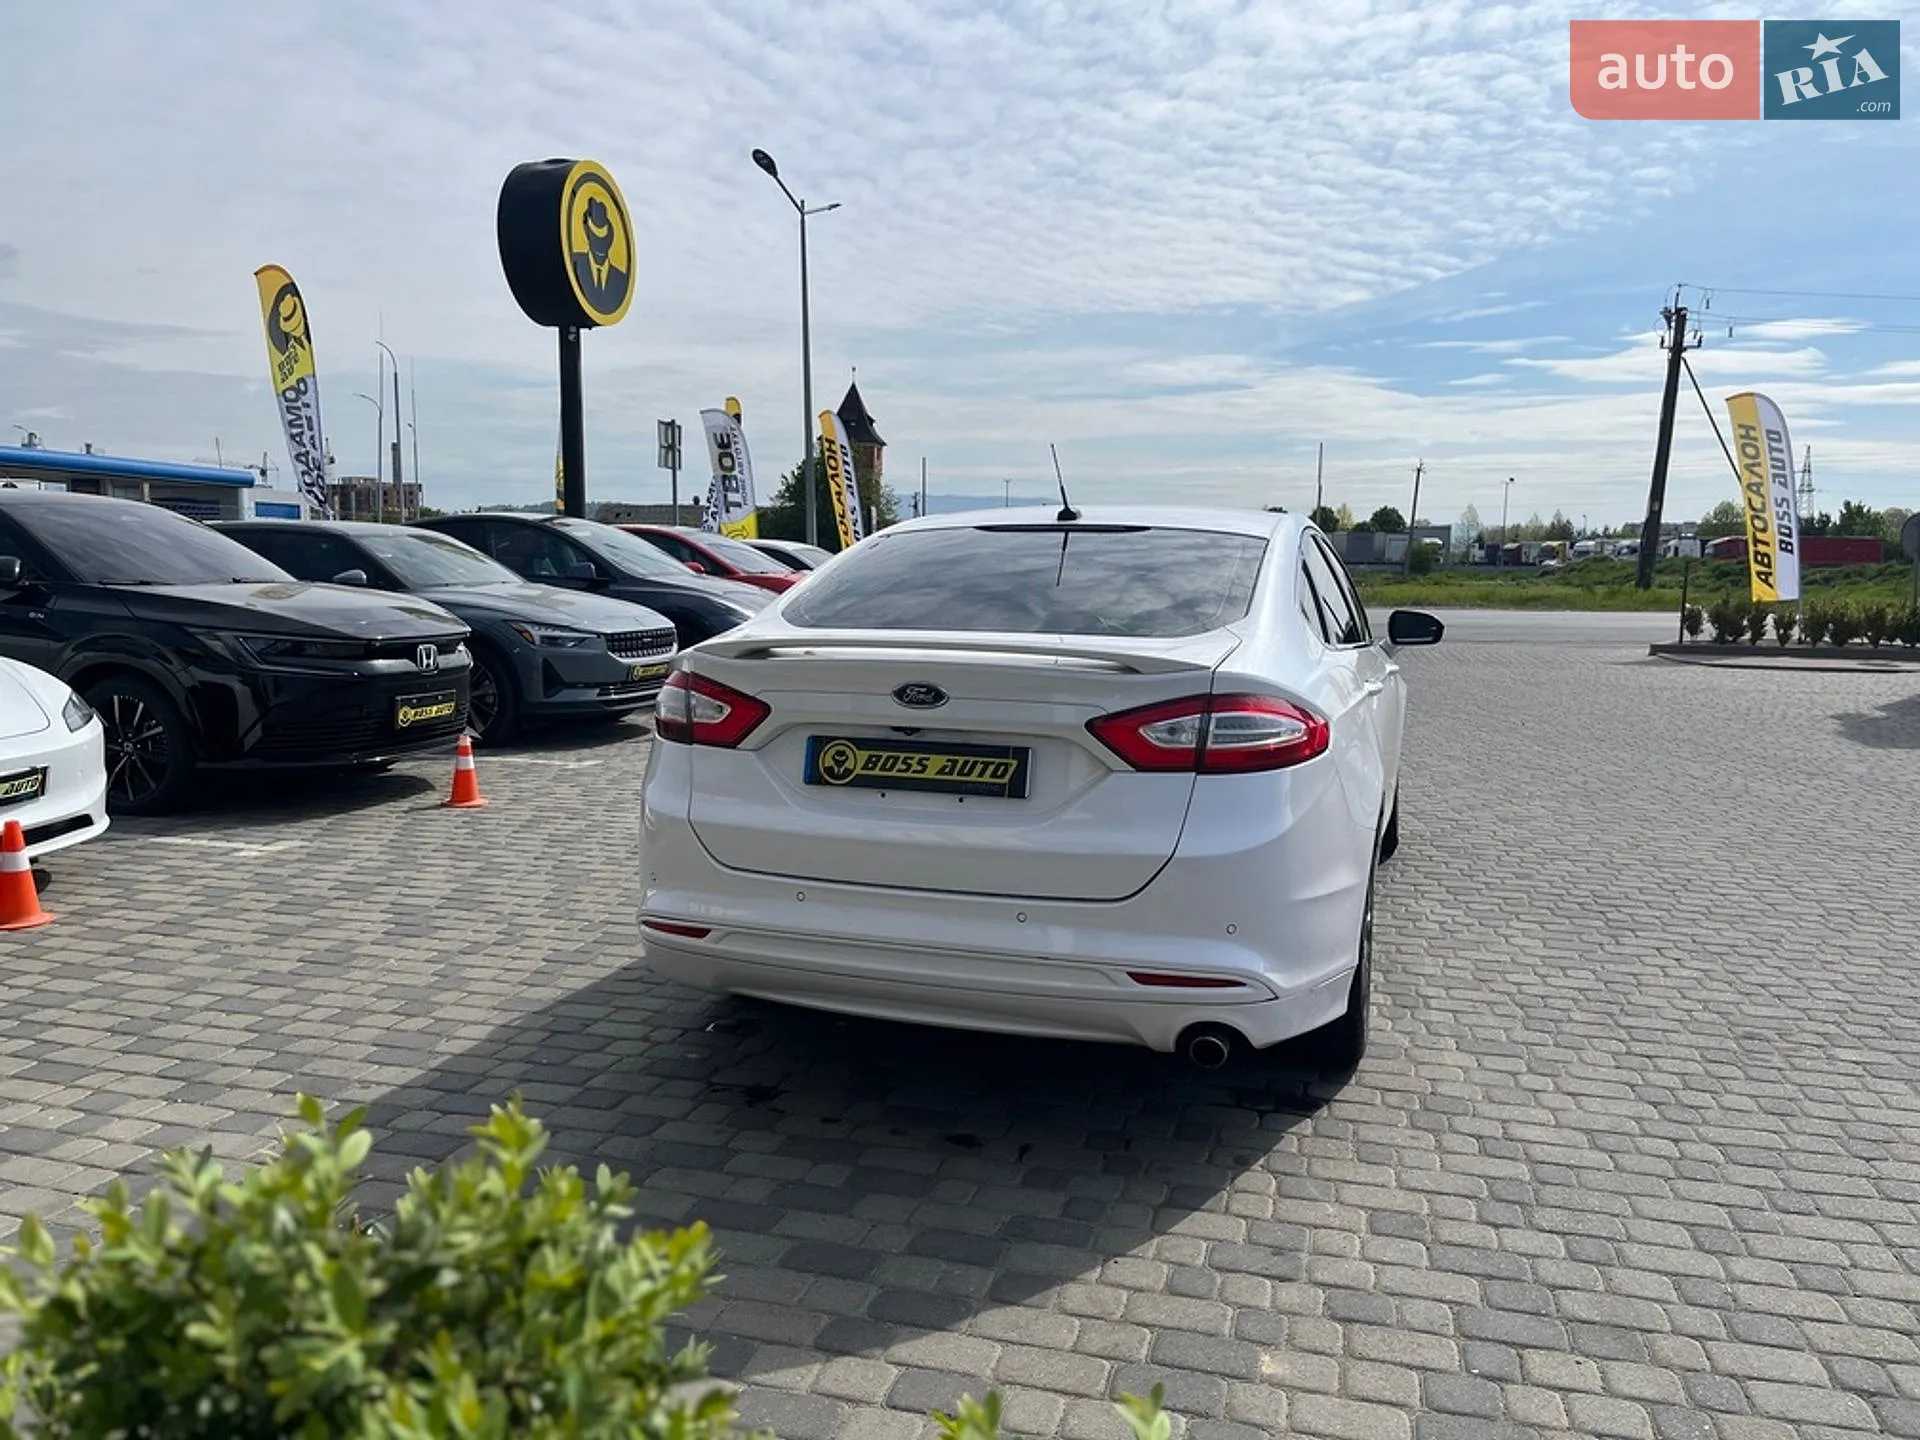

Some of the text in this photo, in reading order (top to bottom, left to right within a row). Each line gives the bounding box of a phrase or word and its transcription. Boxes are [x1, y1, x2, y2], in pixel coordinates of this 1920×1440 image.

[1737, 424, 1774, 590] АВТОСАЛОН
[1766, 428, 1795, 556] BOSS AUTO
[903, 686, 936, 702] Ford
[861, 753, 1013, 779] BOSS AUTO
